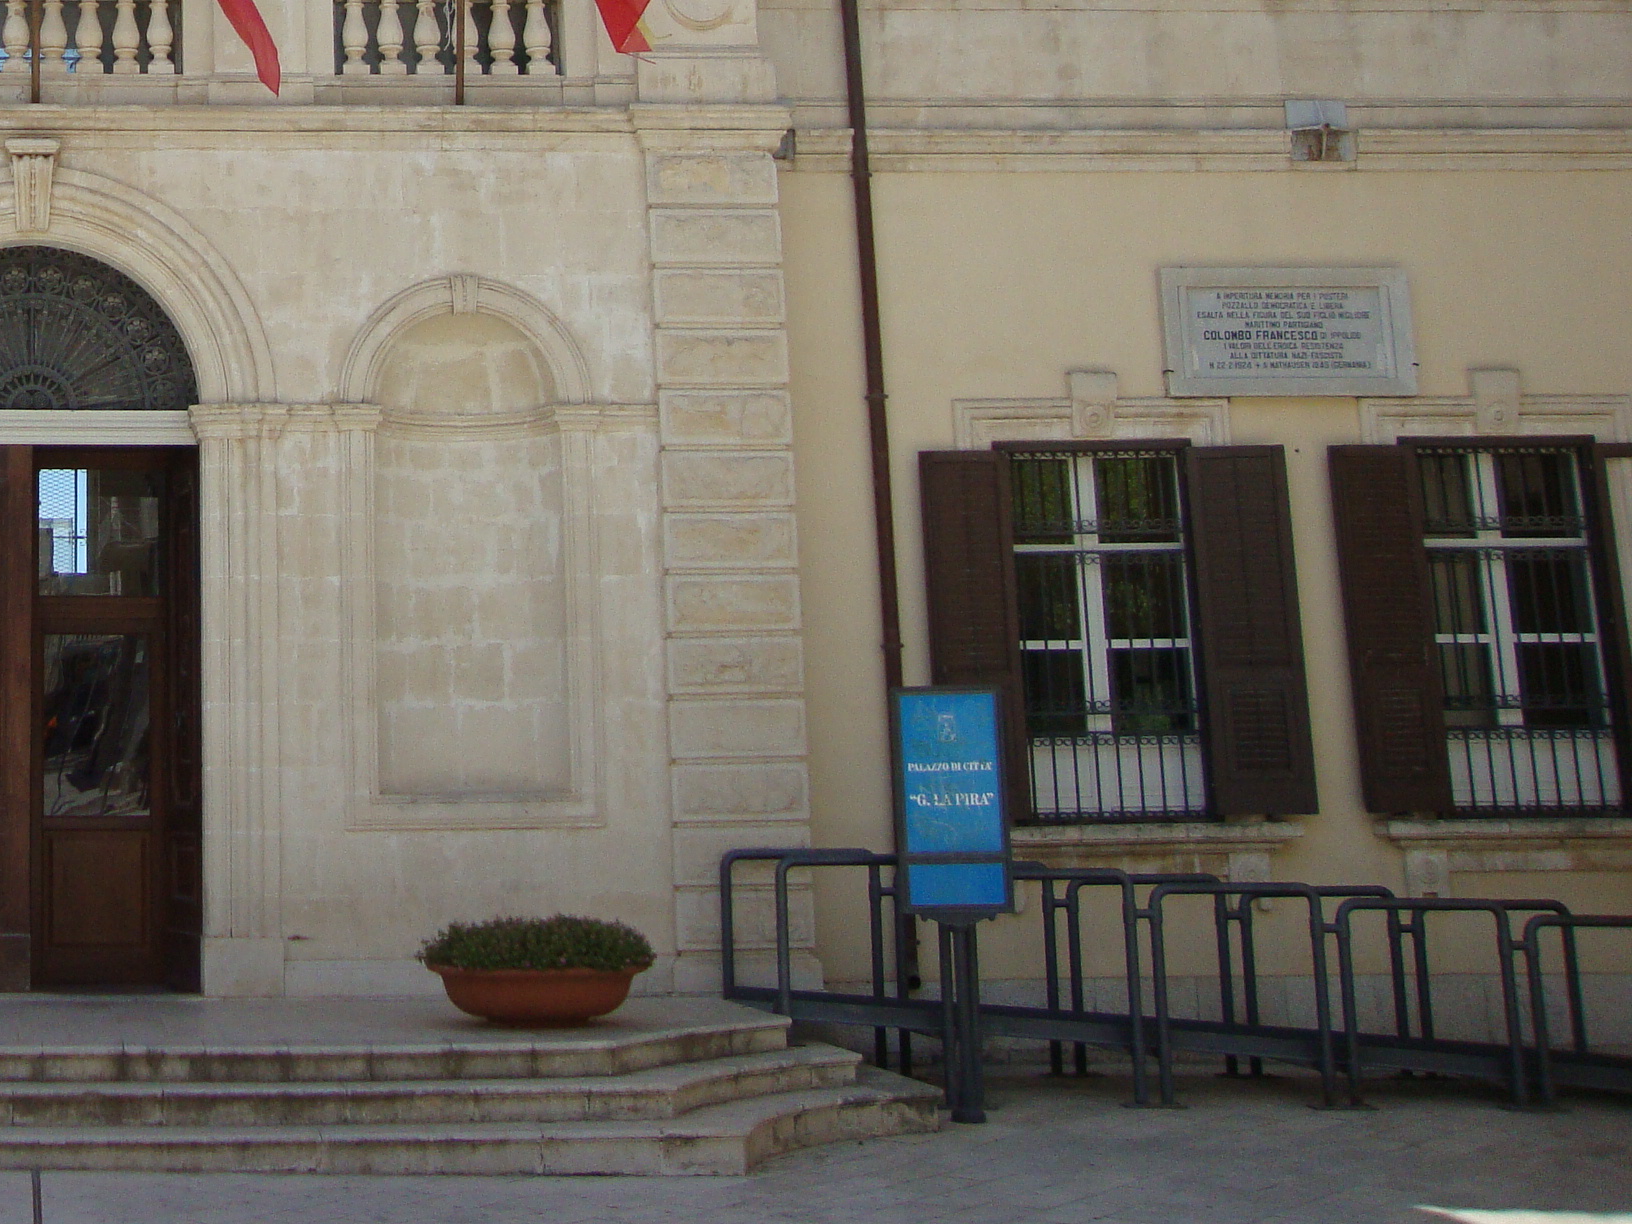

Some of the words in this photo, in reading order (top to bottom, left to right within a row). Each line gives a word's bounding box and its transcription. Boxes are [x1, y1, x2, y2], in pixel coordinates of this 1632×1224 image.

[1197, 311, 1223, 319] ESALTA
[1227, 311, 1249, 319] NELLA
[1297, 311, 1310, 319] SUO
[1203, 330, 1252, 340] COLOMBO
[1256, 330, 1318, 340] FRANCESCO
[907, 762, 949, 772] PALAZZO
[951, 762, 961, 771] DI
[934, 793, 952, 806] LA
